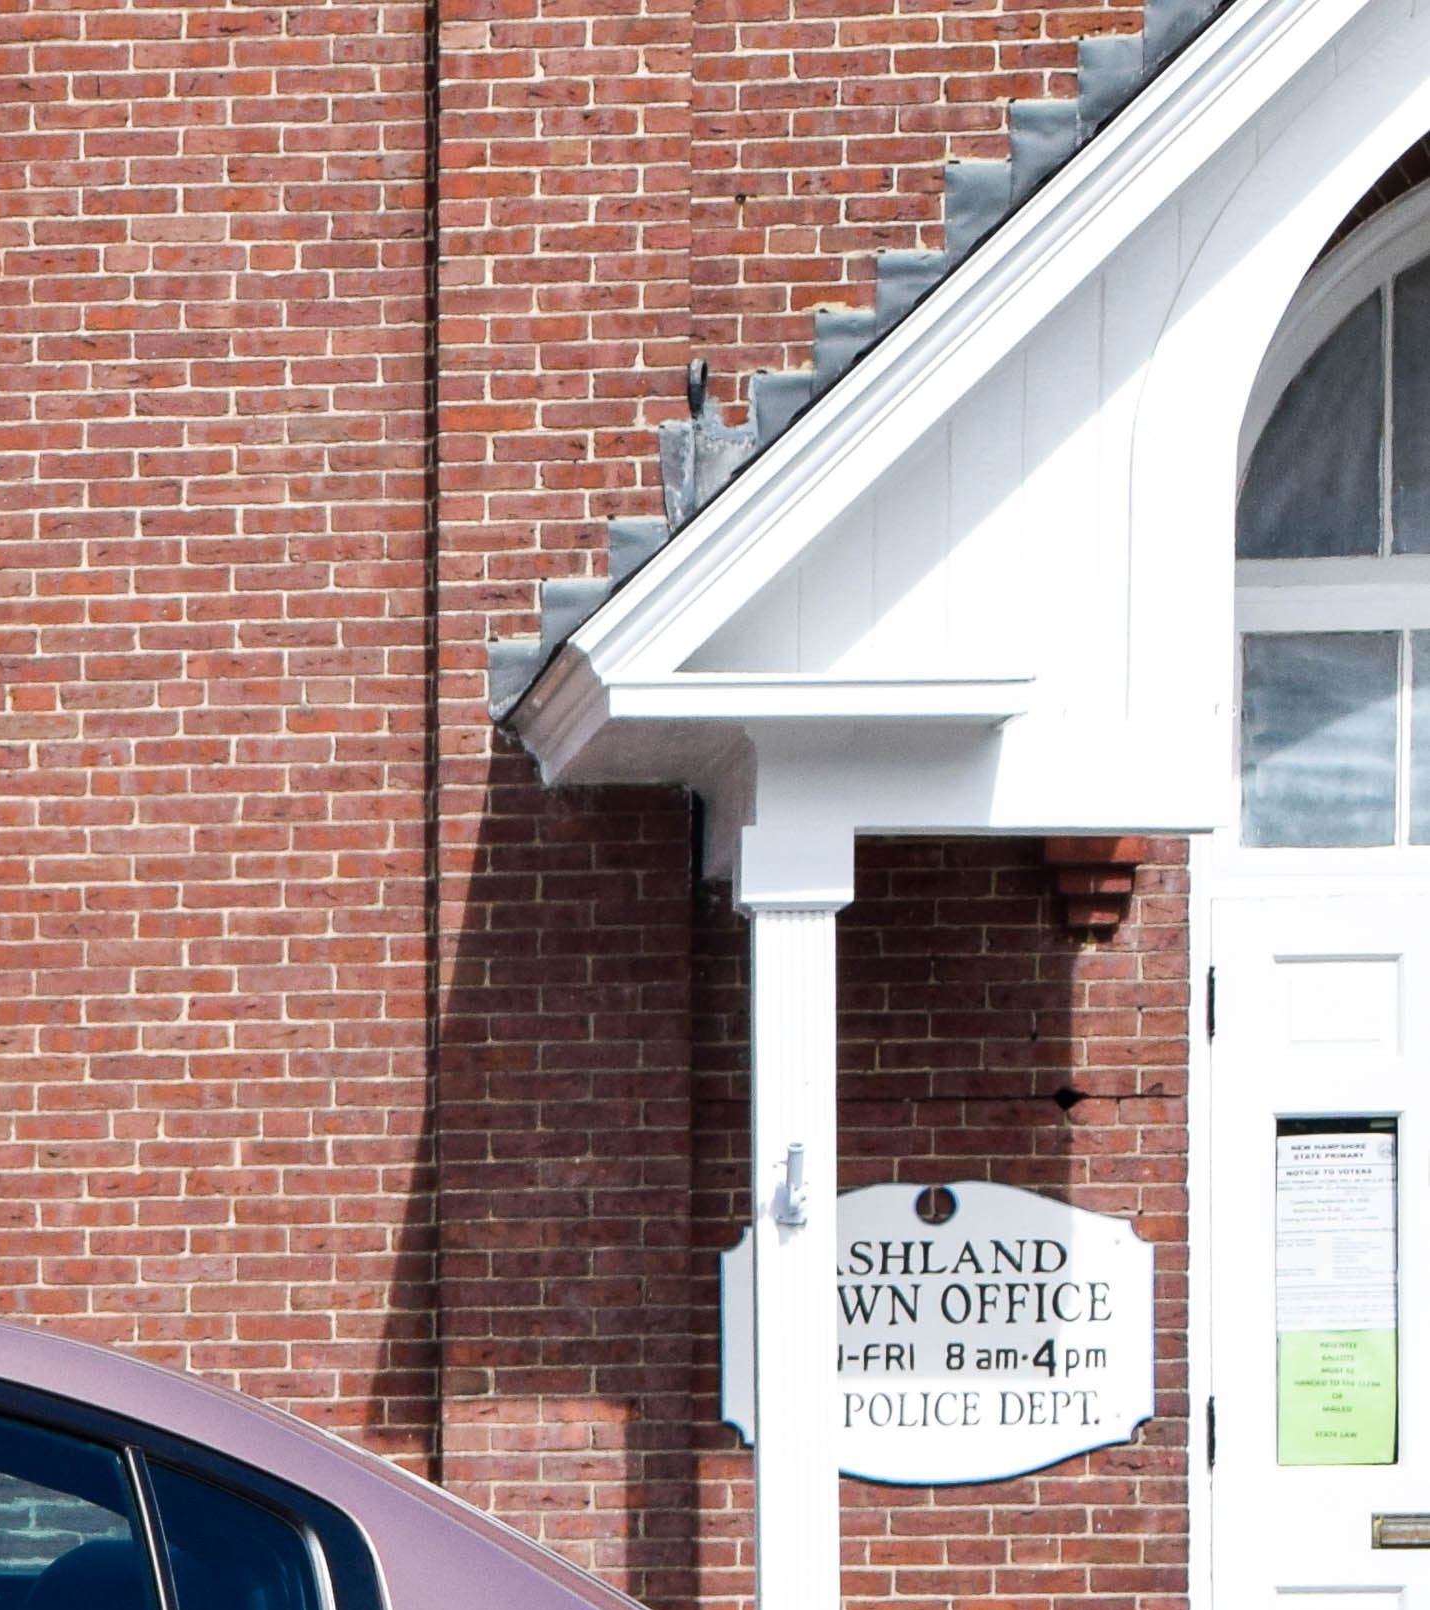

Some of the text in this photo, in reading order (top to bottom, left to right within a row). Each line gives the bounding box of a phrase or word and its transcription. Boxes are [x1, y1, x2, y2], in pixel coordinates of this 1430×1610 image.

[1286, 1169, 1319, 1177] NOTICE
[837, 1240, 1068, 1276] SHLAND
[837, 1281, 1113, 1325] WN OFFICE
[837, 1343, 915, 1372] -FRI
[843, 1389, 1101, 1428] POLICE DEPT.
